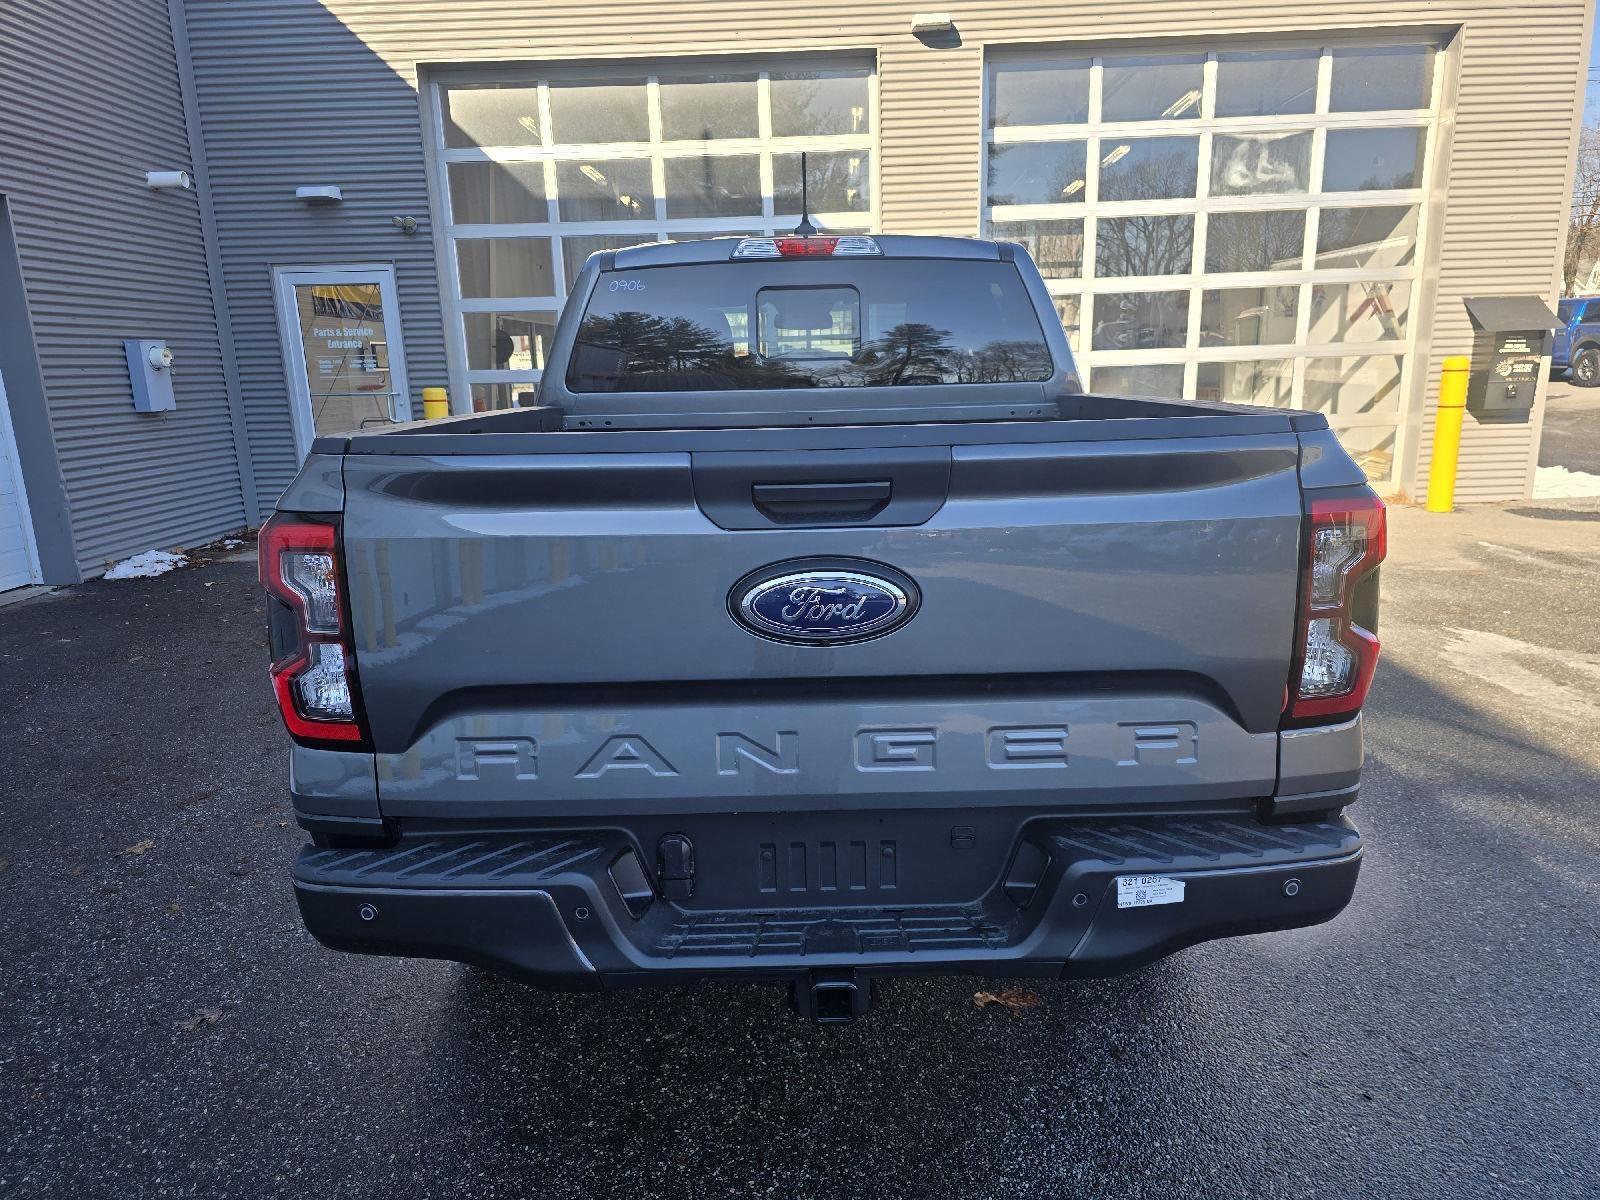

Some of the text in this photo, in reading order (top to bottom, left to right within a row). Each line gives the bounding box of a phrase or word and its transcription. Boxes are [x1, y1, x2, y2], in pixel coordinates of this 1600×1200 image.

[608, 279, 646, 292] 0906
[313, 327, 374, 337] Parts & Service
[327, 340, 363, 349] Entrance
[781, 586, 867, 622] Ford
[455, 719, 1199, 781] RANGER
